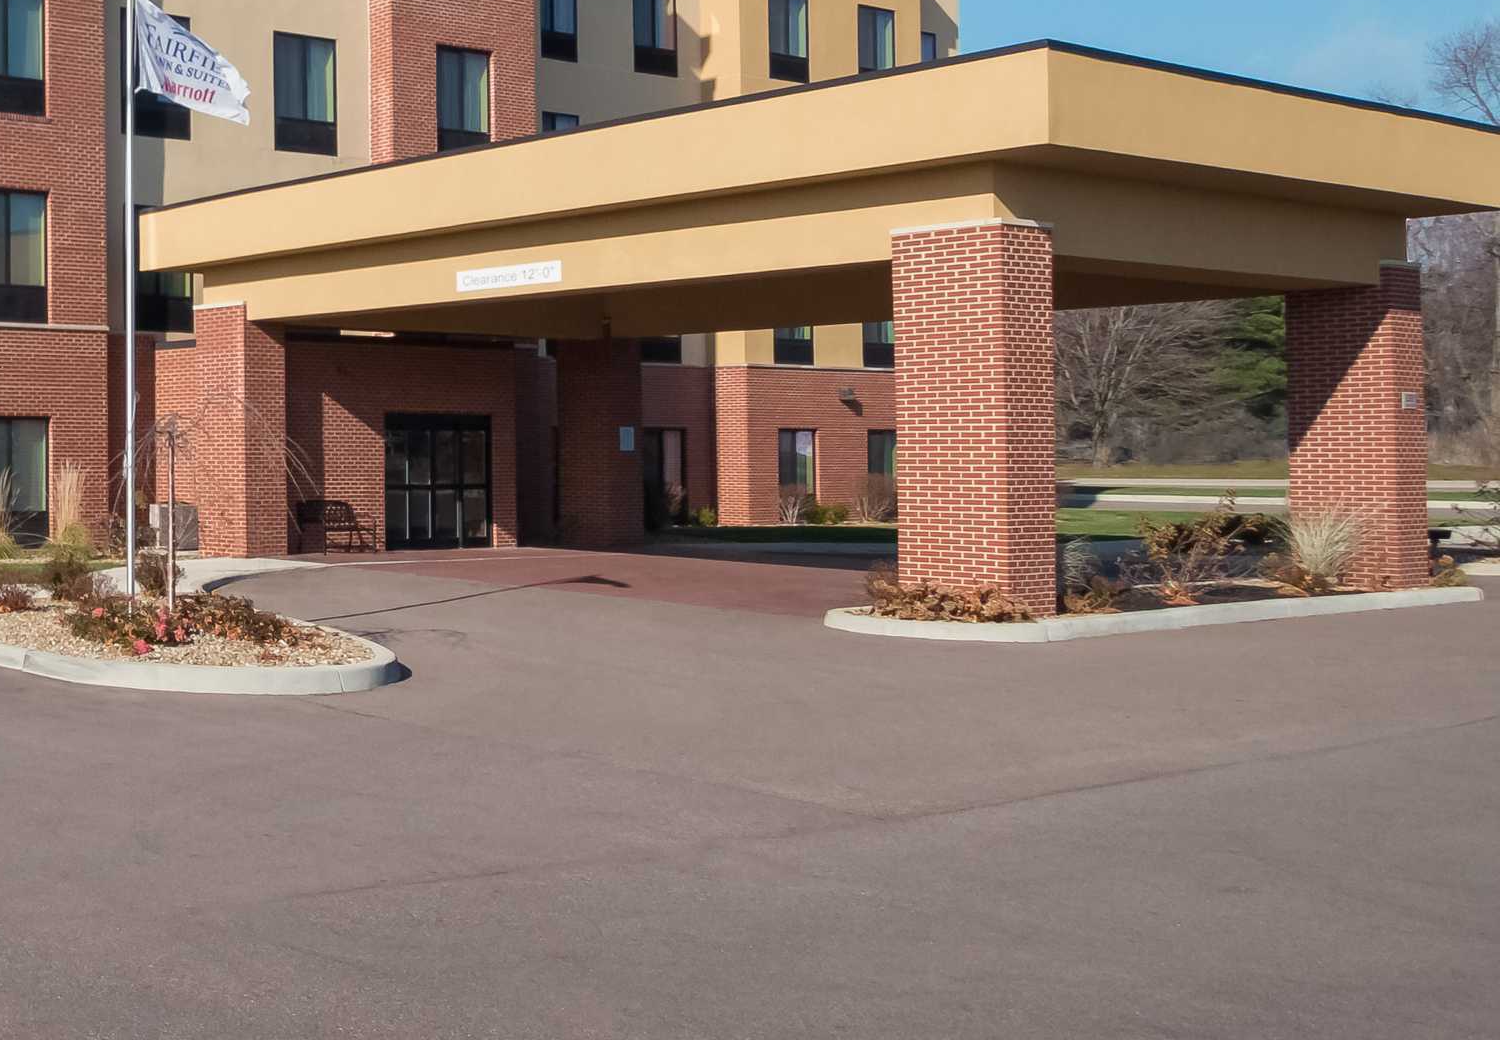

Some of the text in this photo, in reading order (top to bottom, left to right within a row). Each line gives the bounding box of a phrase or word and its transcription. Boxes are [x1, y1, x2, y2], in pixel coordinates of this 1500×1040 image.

[145, 23, 226, 78] FAIRFIE
[174, 63, 184, 76] &
[462, 271, 518, 288] Clearance
